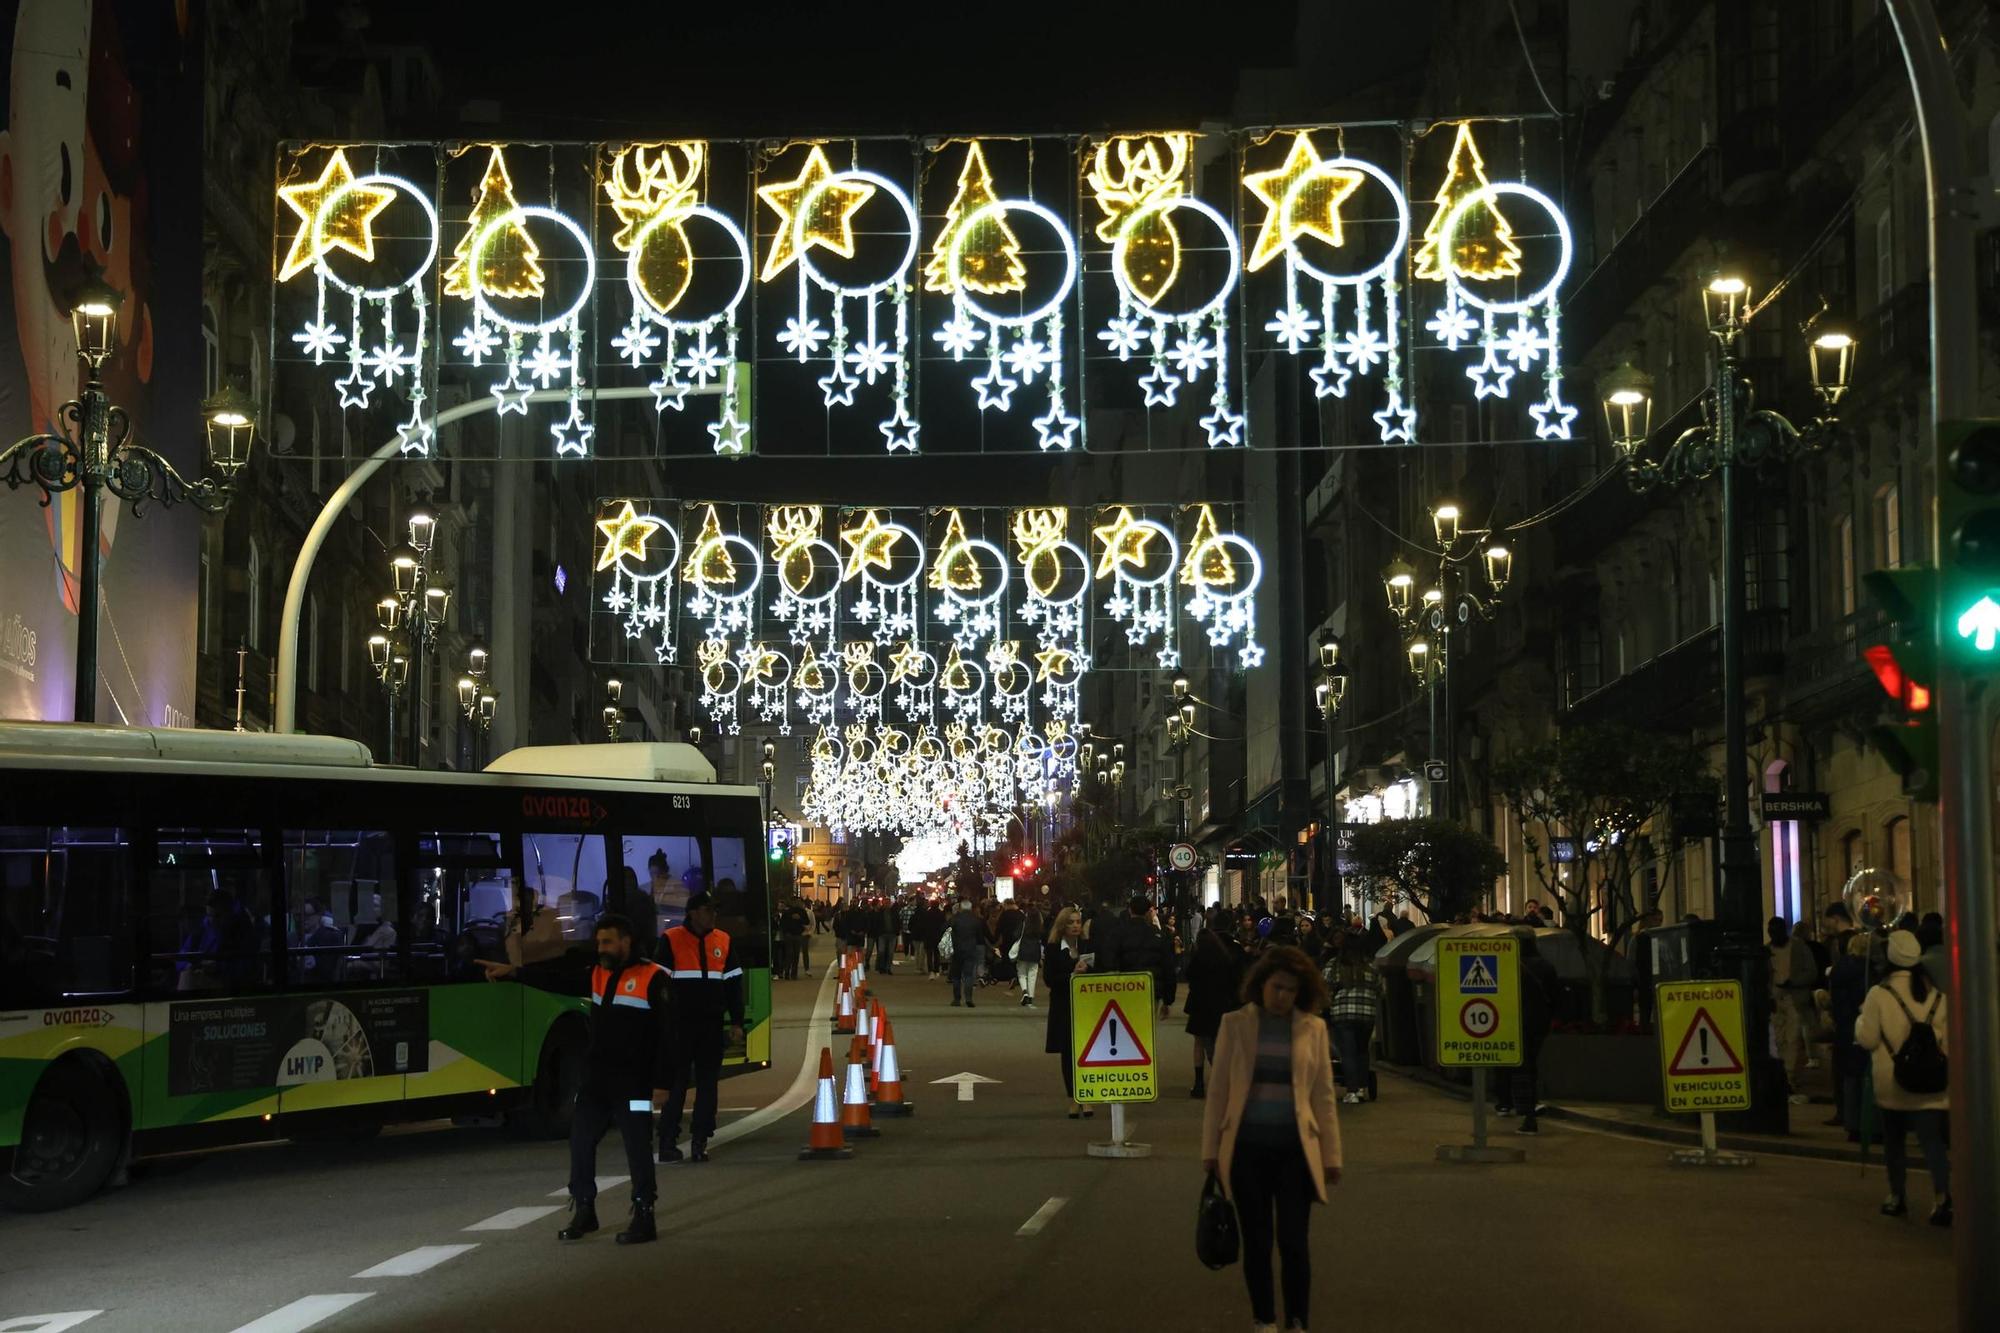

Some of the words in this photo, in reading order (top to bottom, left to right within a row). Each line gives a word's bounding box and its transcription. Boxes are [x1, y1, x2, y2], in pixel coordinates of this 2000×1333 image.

[672, 795, 691, 809] 6213
[1765, 801, 1823, 812] BERSHKA
[1176, 852, 1191, 861] 40
[43, 1008, 100, 1026] avanza
[1470, 1011, 1489, 1025] 10
[203, 1023, 267, 1040] SOLUCIONES
[1444, 1040, 1516, 1051] PRIORIDADE
[1458, 1052, 1502, 1062] PEONIL
[287, 1055, 324, 1076] LHYP
[1078, 1088, 1094, 1098] EN
[1100, 1087, 1152, 1097] CALZADA
[1671, 1097, 1687, 1107] EN
[1693, 1095, 1745, 1105] CALZADA
